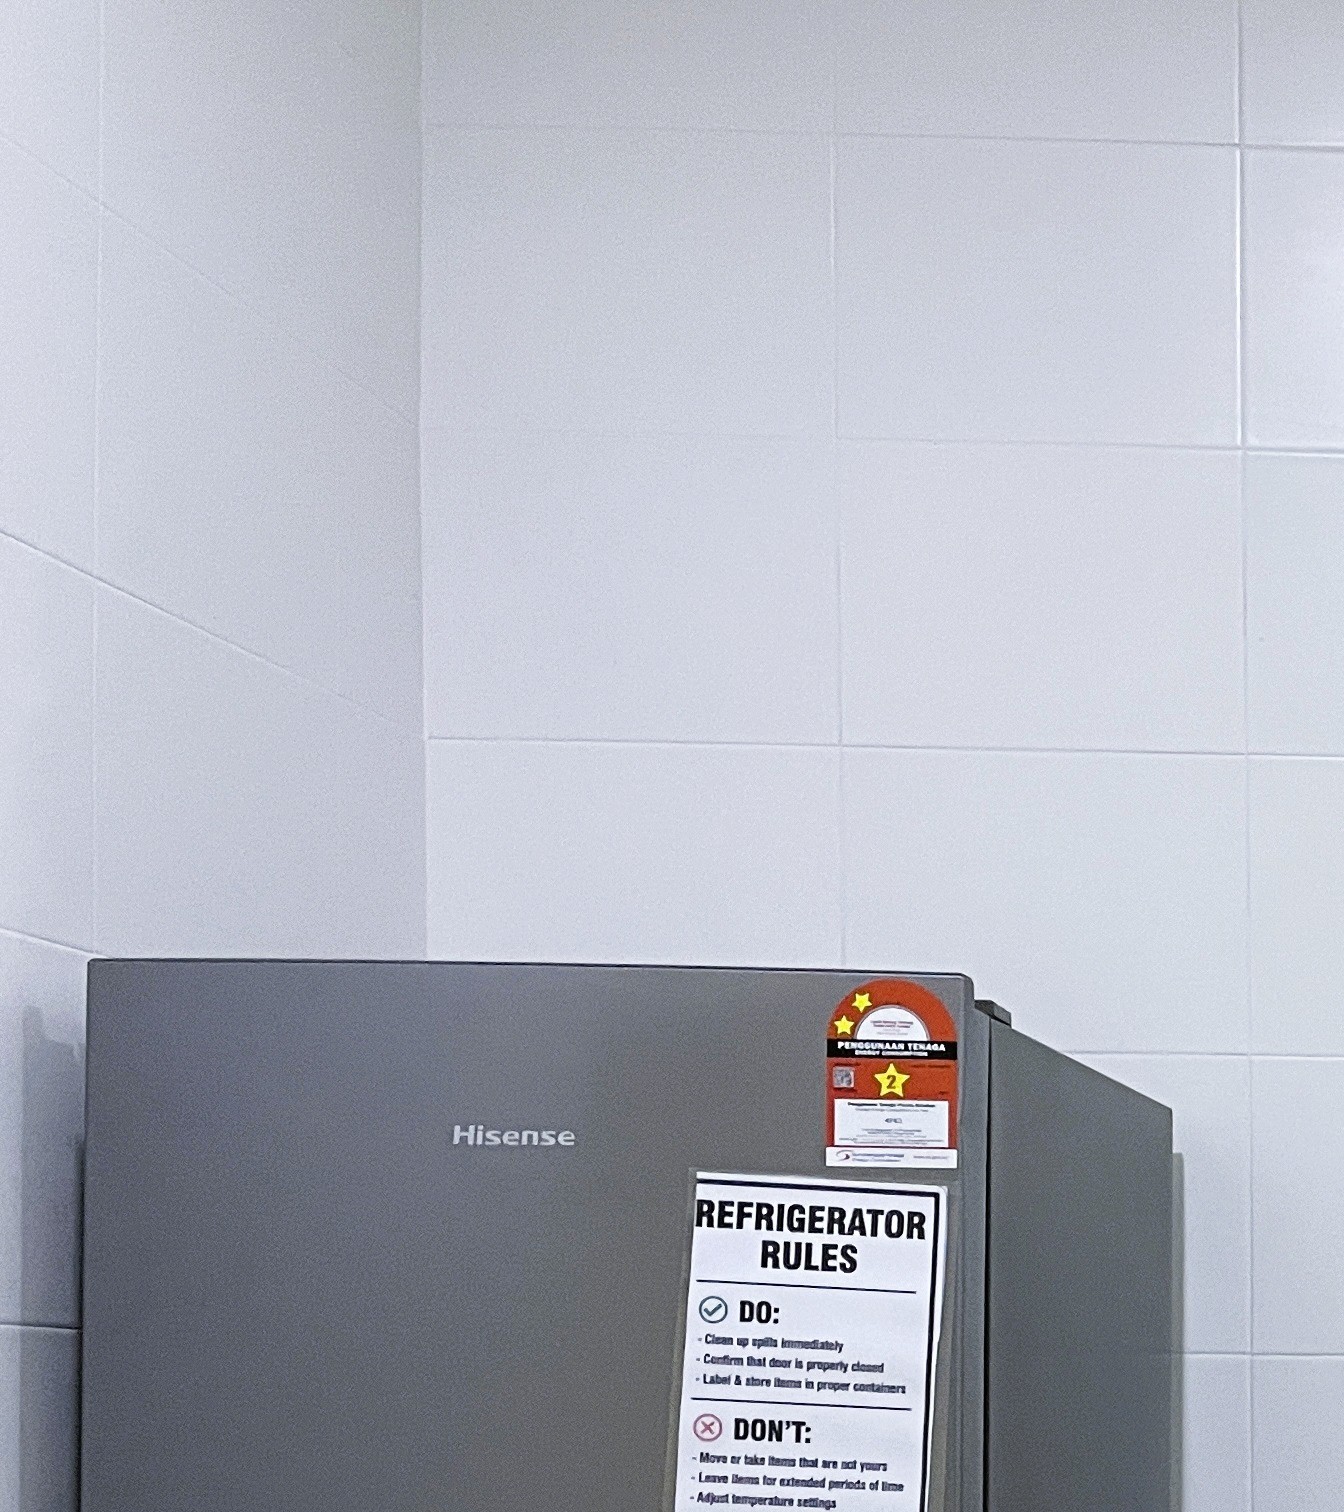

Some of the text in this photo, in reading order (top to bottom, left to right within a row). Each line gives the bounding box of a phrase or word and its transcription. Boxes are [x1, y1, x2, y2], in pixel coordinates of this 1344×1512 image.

[907, 1043, 946, 1051] TENAGA
[886, 1074, 897, 1089] 2
[453, 1125, 575, 1146] Hisense
[695, 1199, 926, 1240] REFRIGERATOR
[760, 1240, 858, 1273] RULES
[739, 1300, 780, 1324] DO:
[704, 1333, 844, 1353] Clean up spills immediately
[703, 1353, 884, 1373] Confirm that door is properly closed
[703, 1374, 906, 1394] Label & store items in proper containers
[734, 1417, 811, 1444] DON'T:
[700, 1452, 887, 1473] Move or take items that are not yours
[699, 1472, 904, 1492] Leave items for extended periods of time
[697, 1492, 836, 1510] Adjust temperature settings
